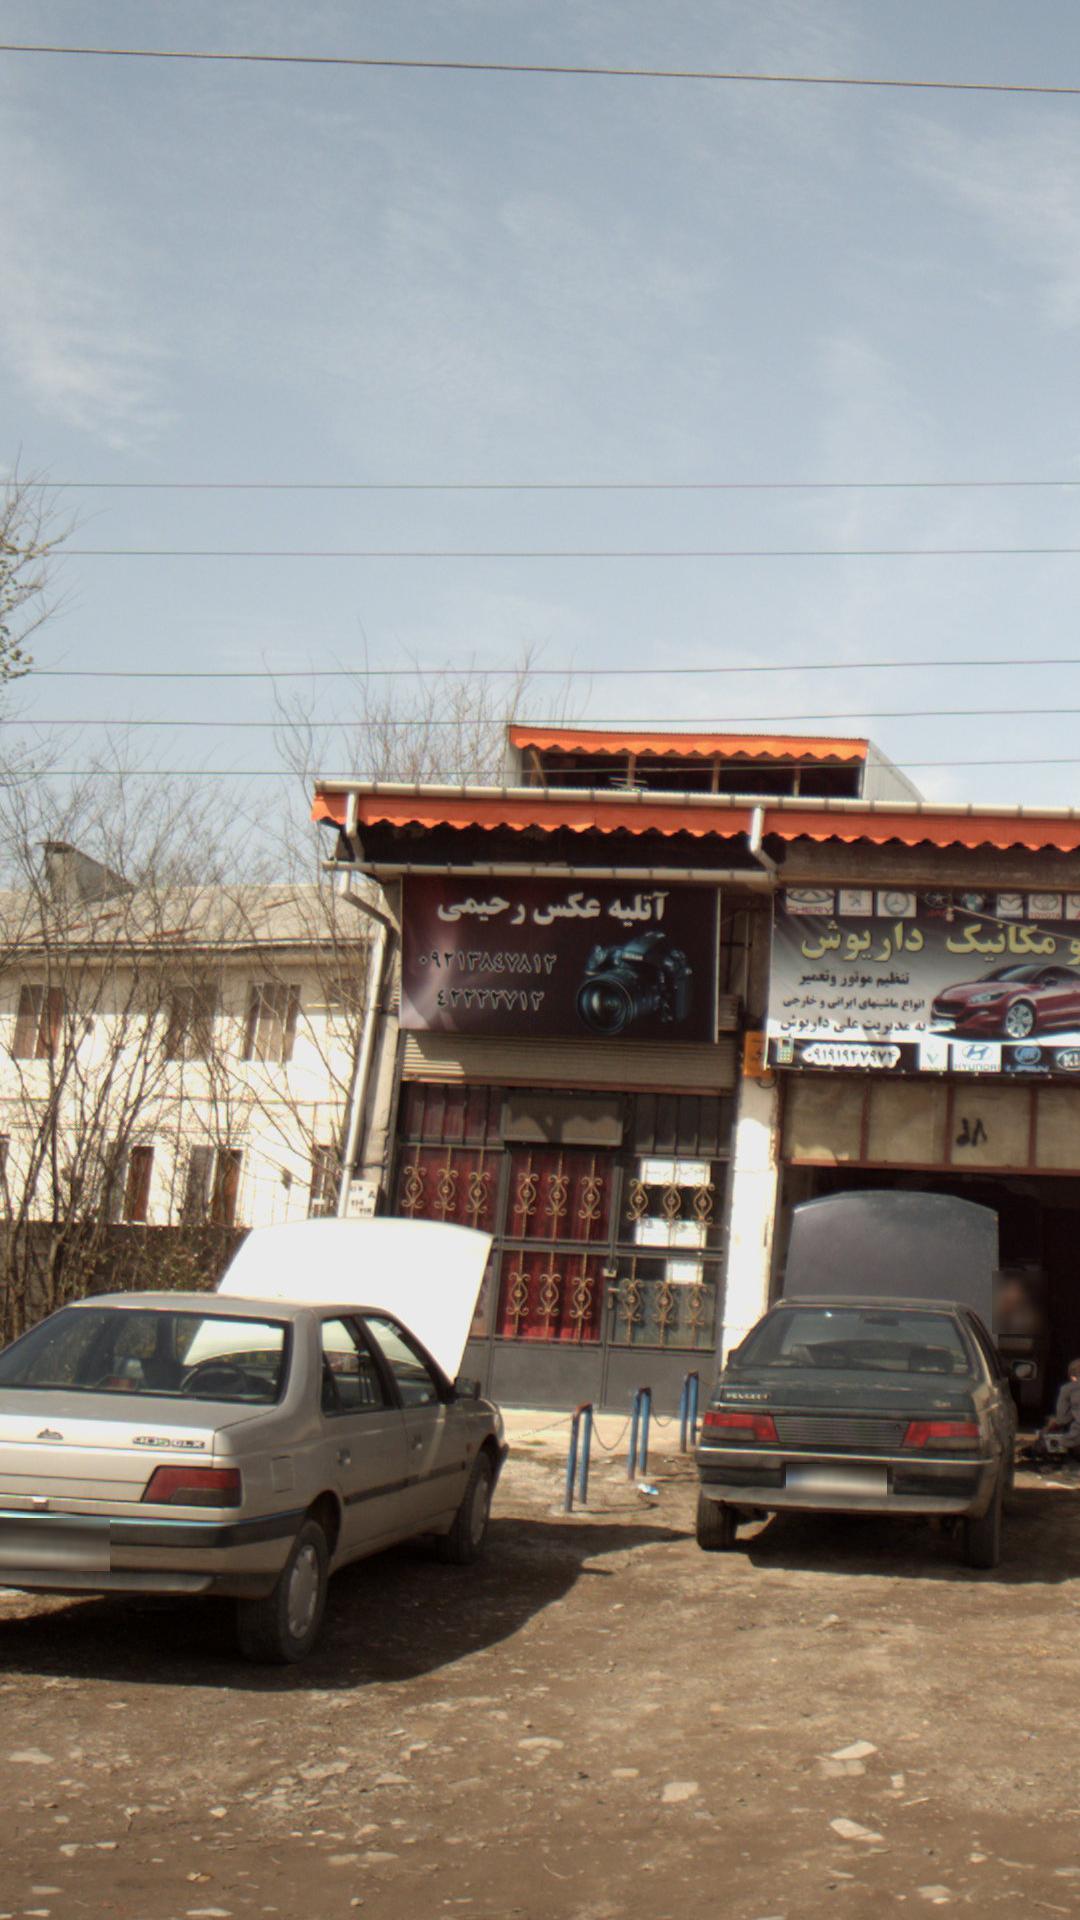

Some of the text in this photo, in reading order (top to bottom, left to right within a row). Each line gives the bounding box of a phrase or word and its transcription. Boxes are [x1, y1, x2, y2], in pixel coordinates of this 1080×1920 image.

[437, 892, 669, 928] آتلیه عکس رحیمی
[801, 920, 924, 961] داریوش
[946, 923, 1056, 962] مکانیک
[876, 971, 910, 988] تنظیم
